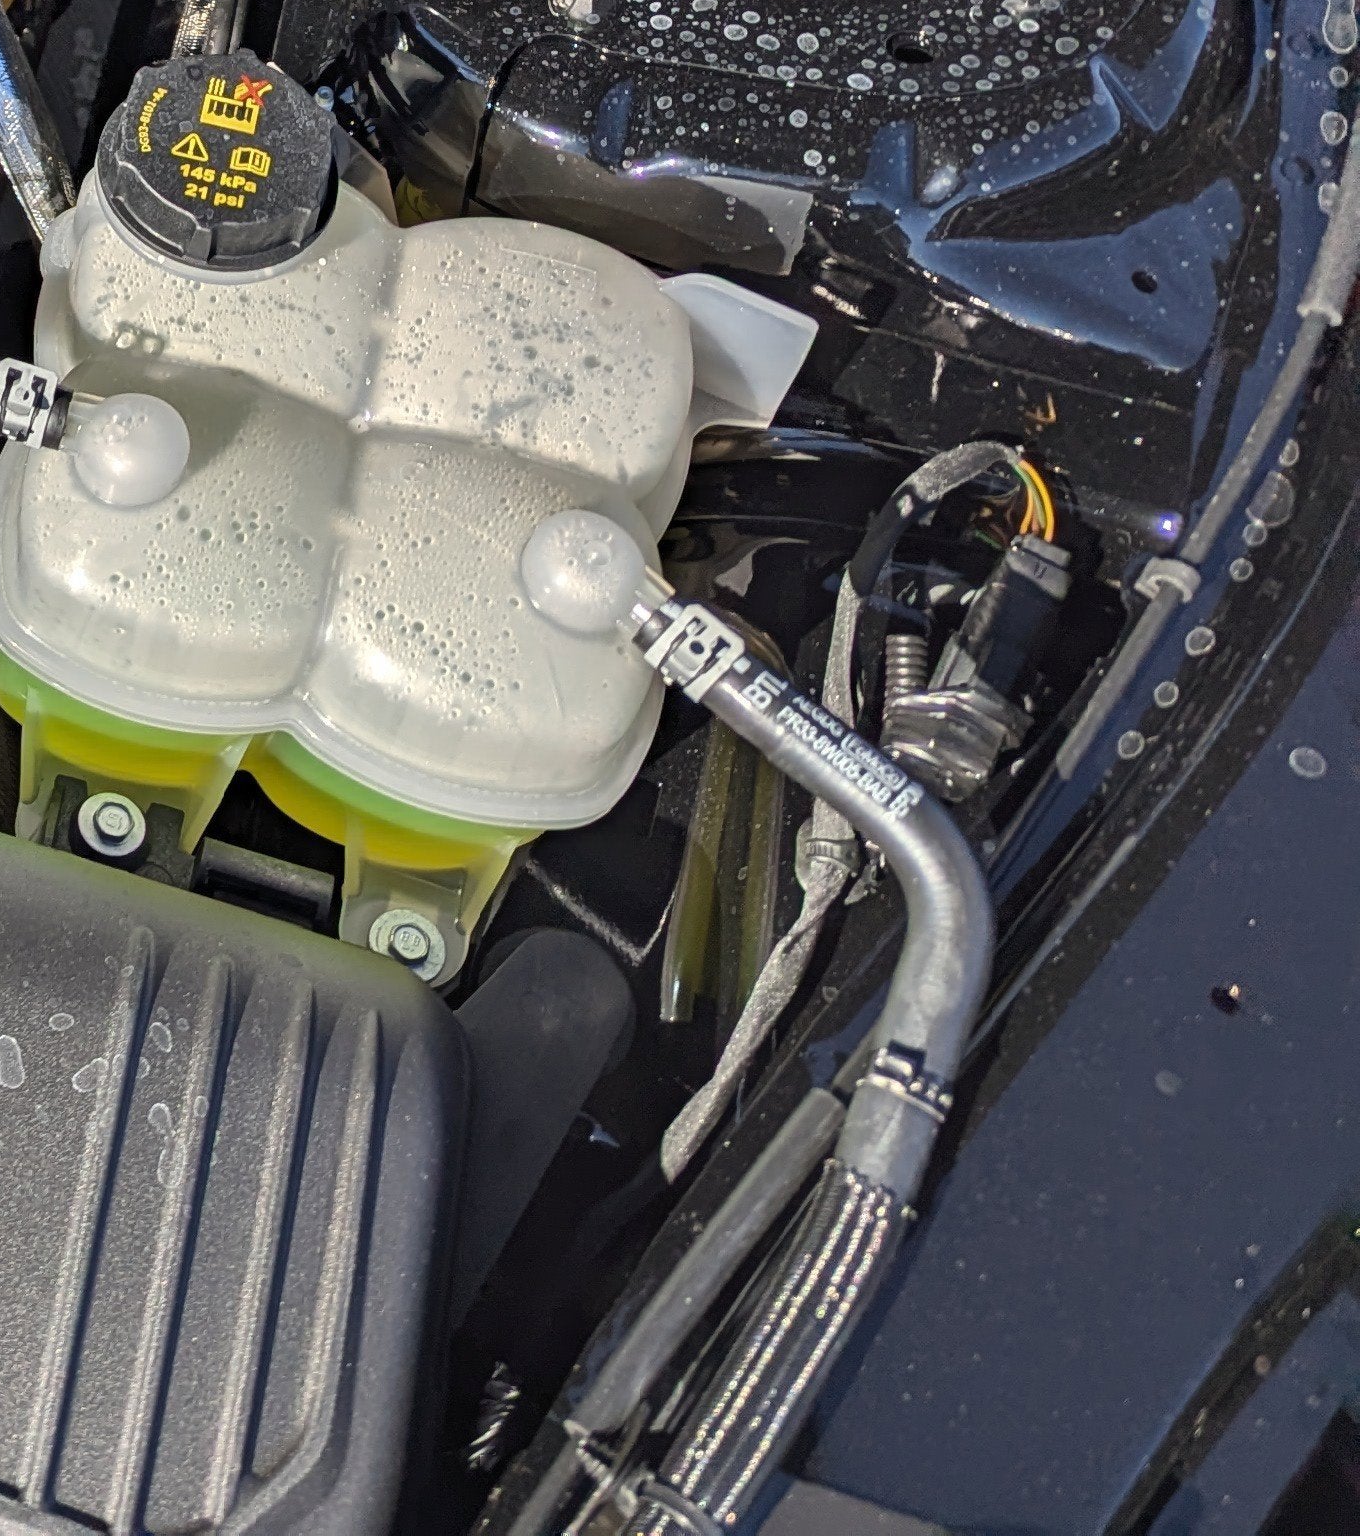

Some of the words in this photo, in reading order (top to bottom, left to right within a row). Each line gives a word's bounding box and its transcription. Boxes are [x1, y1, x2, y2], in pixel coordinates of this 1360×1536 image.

[180, 163, 216, 184] 145
[219, 172, 258, 194] kPa
[184, 183, 209, 201] 21
[213, 190, 246, 210] psi
